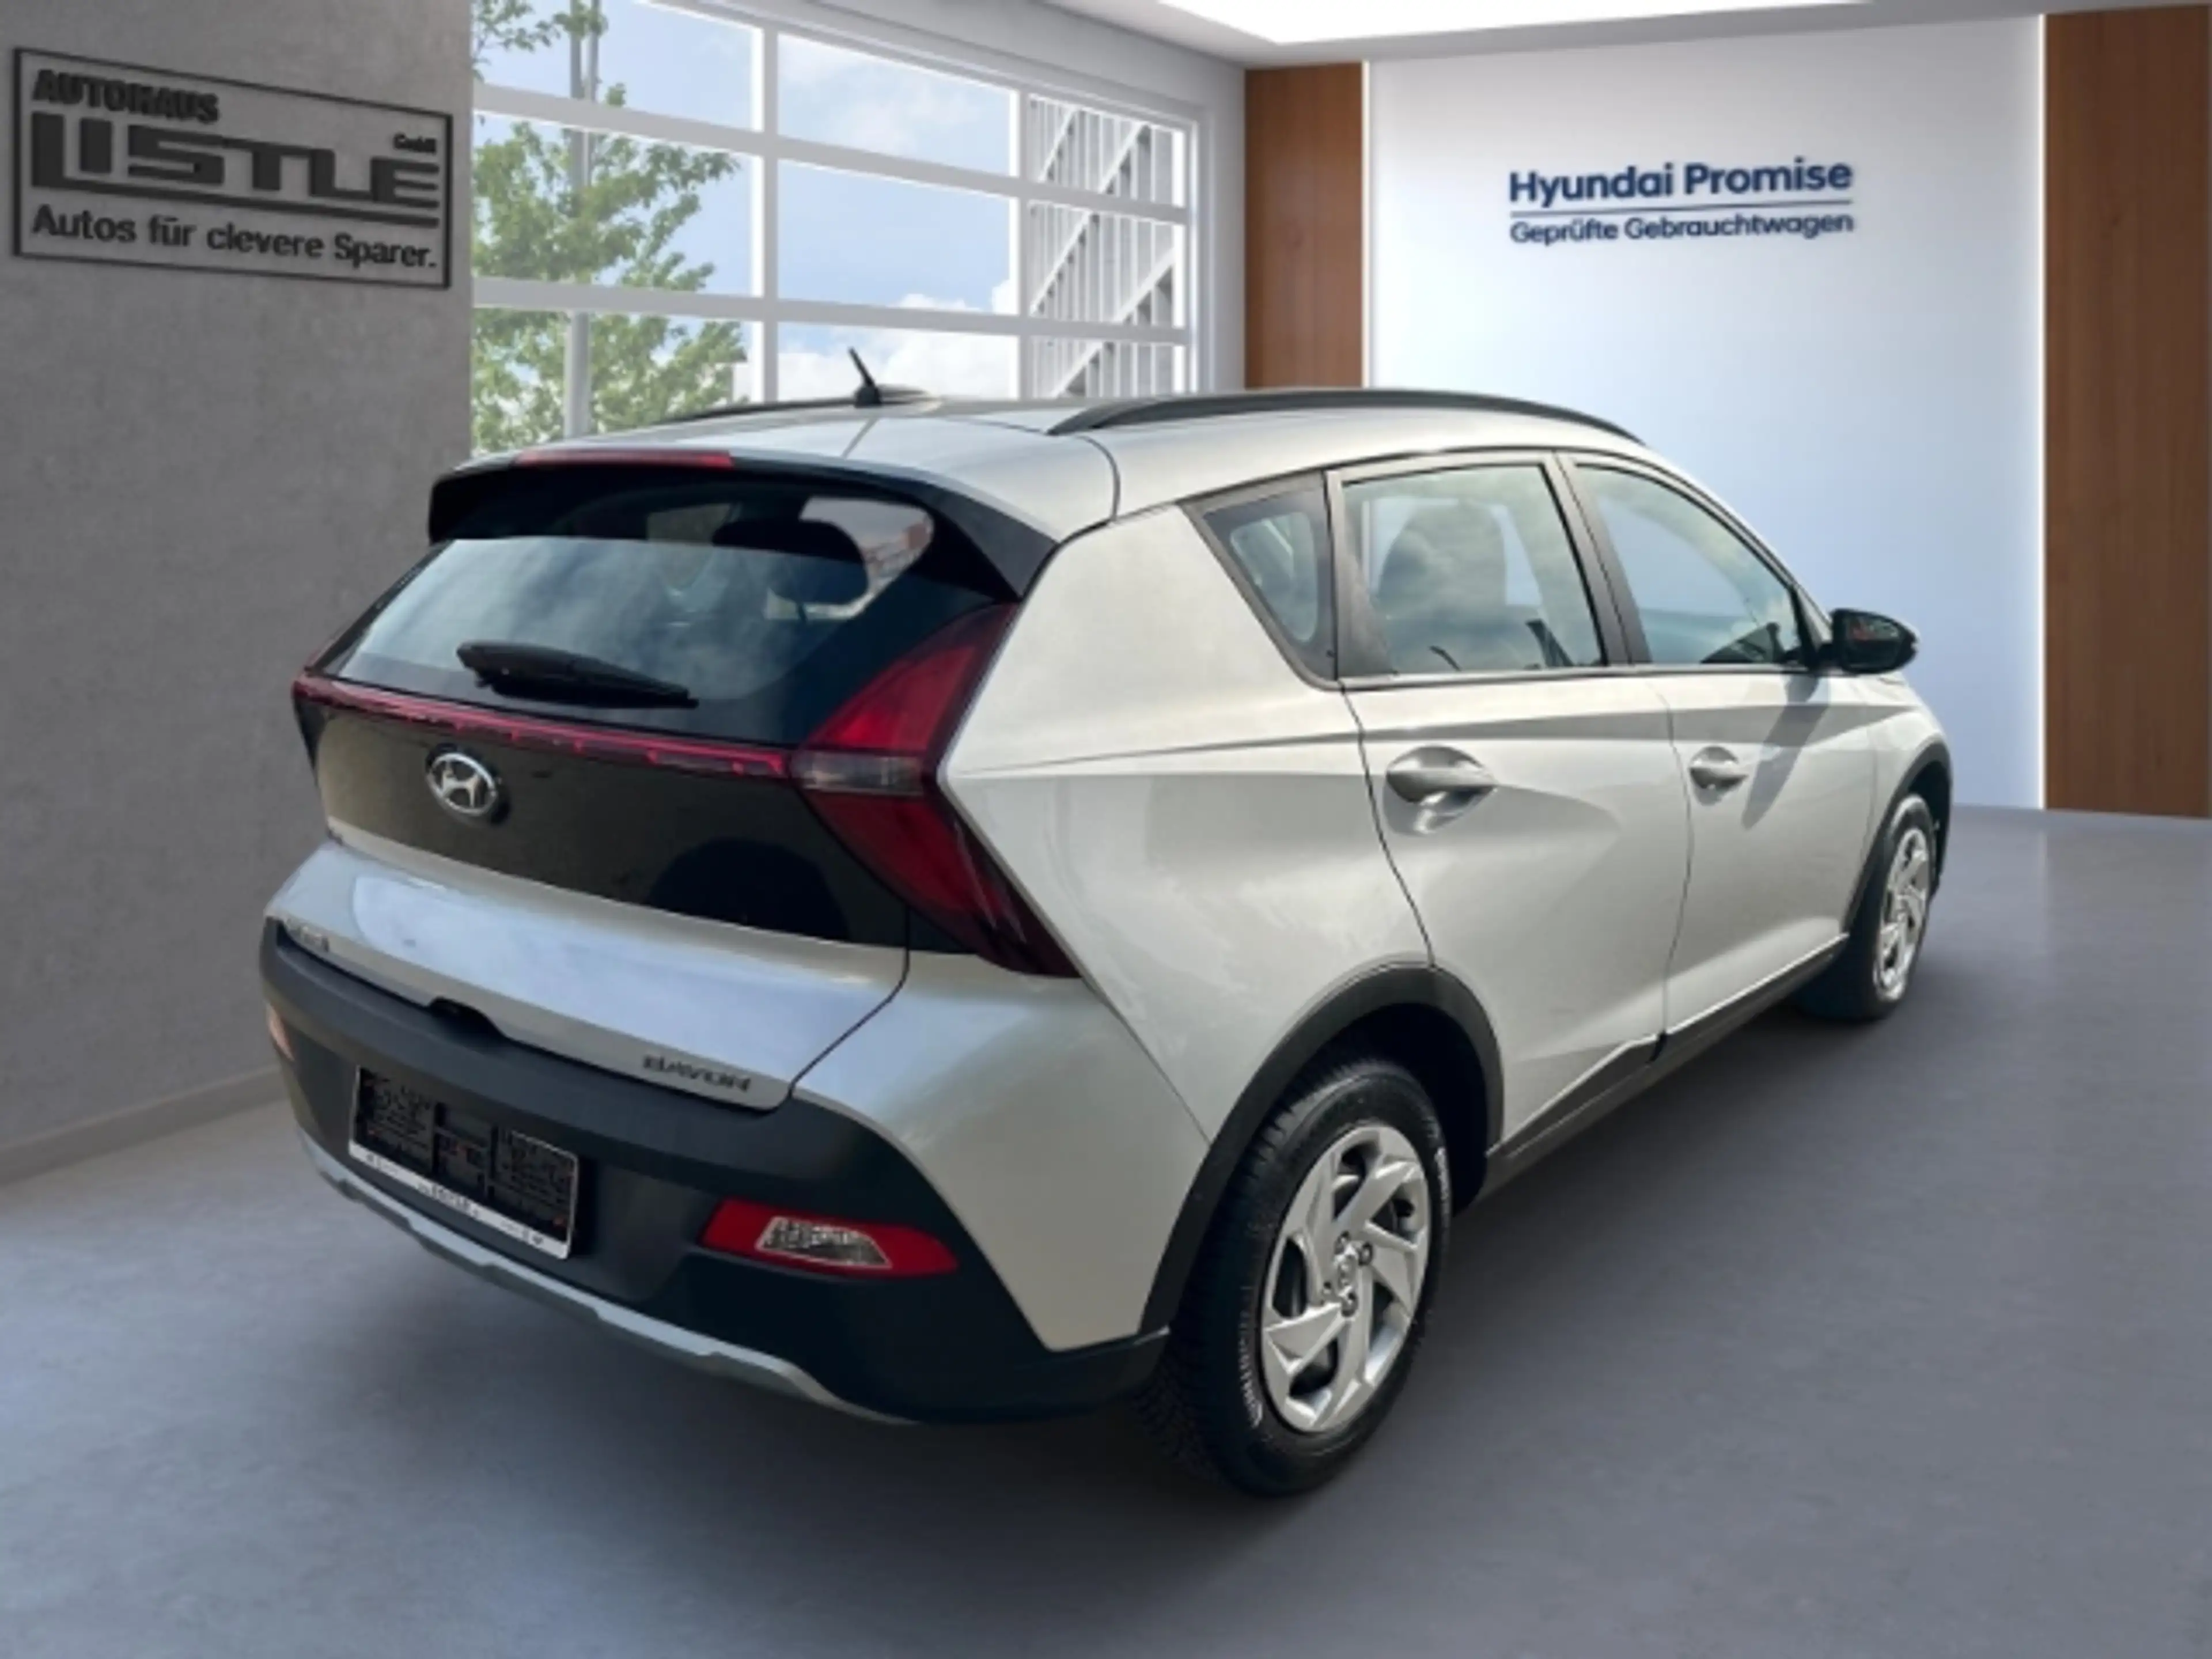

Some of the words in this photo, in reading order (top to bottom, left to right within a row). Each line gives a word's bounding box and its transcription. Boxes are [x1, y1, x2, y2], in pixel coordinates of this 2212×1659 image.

[32, 69, 220, 124] AUTOHAUS
[31, 111, 440, 228] LISTLE
[1509, 161, 1673, 209] Hyundai
[1683, 156, 1853, 195] Promise
[33, 203, 138, 243] Autos
[147, 213, 197, 247] für
[206, 221, 325, 258] clevere
[334, 232, 437, 270] Sparer.
[1509, 218, 1619, 246] Geprüfte
[1623, 213, 1854, 239] Gebrauchtwagen
